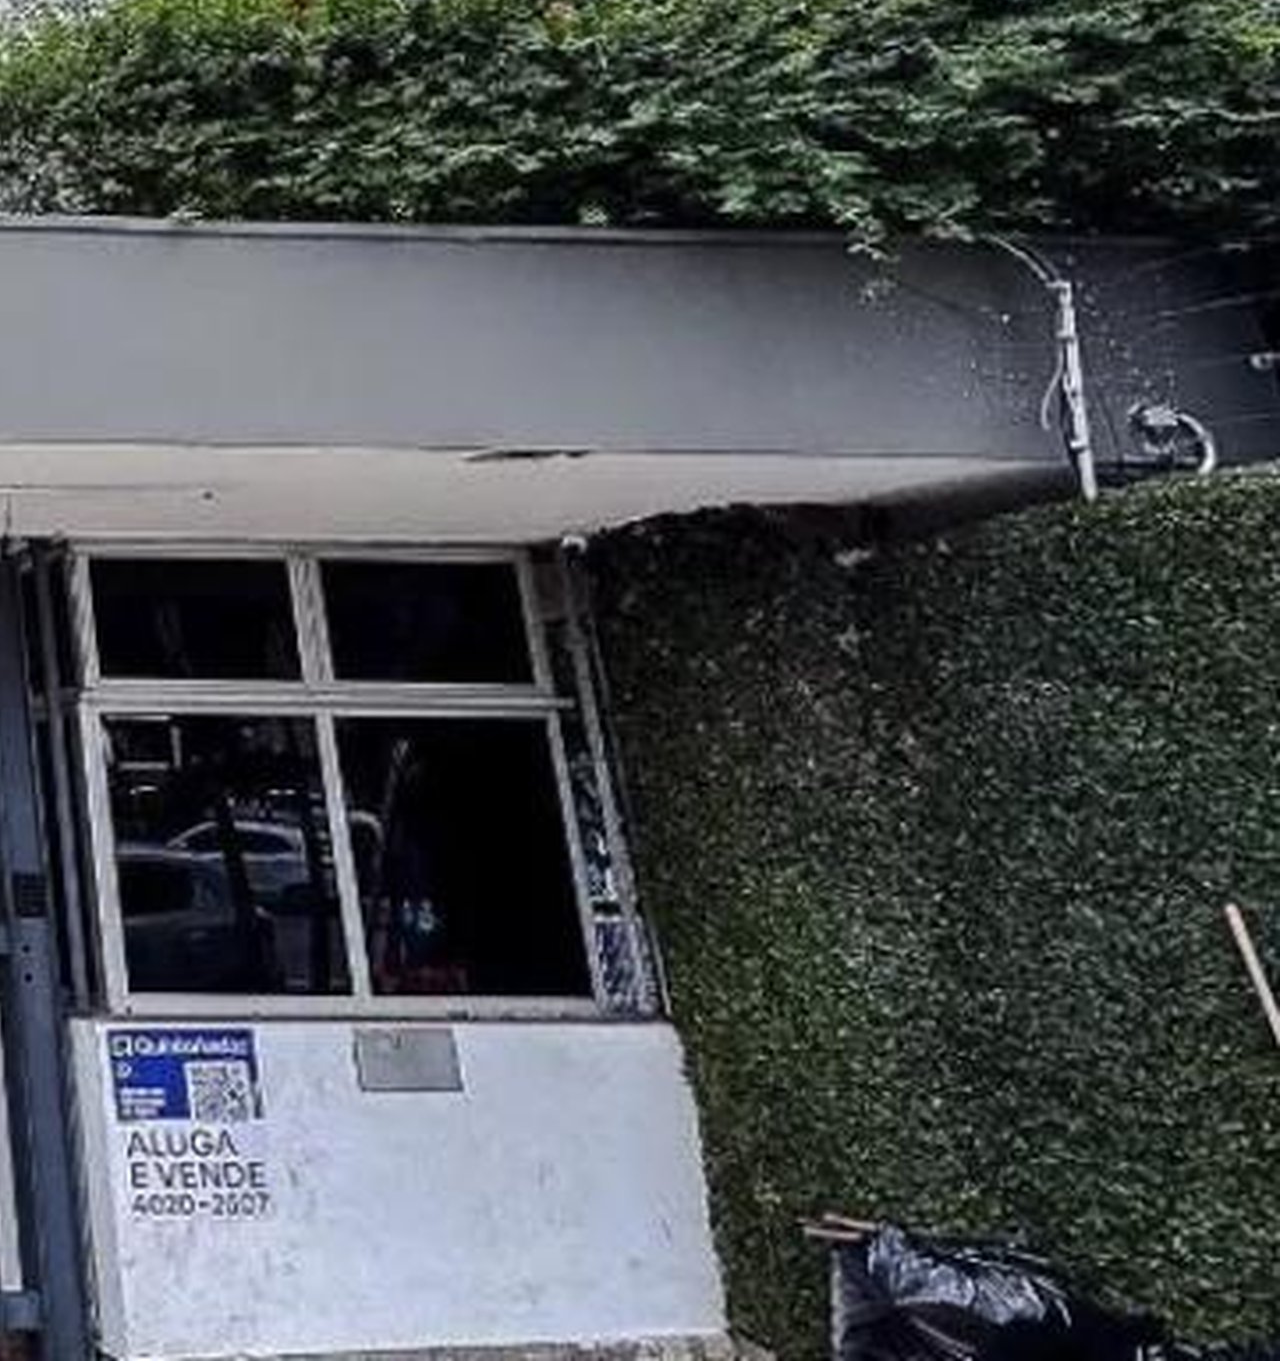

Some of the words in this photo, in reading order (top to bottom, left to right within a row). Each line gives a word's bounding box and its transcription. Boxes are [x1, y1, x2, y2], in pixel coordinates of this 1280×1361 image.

[127, 1129, 239, 1158] ALUGA
[130, 1161, 148, 1188] E
[153, 1161, 267, 1188] VENDE
